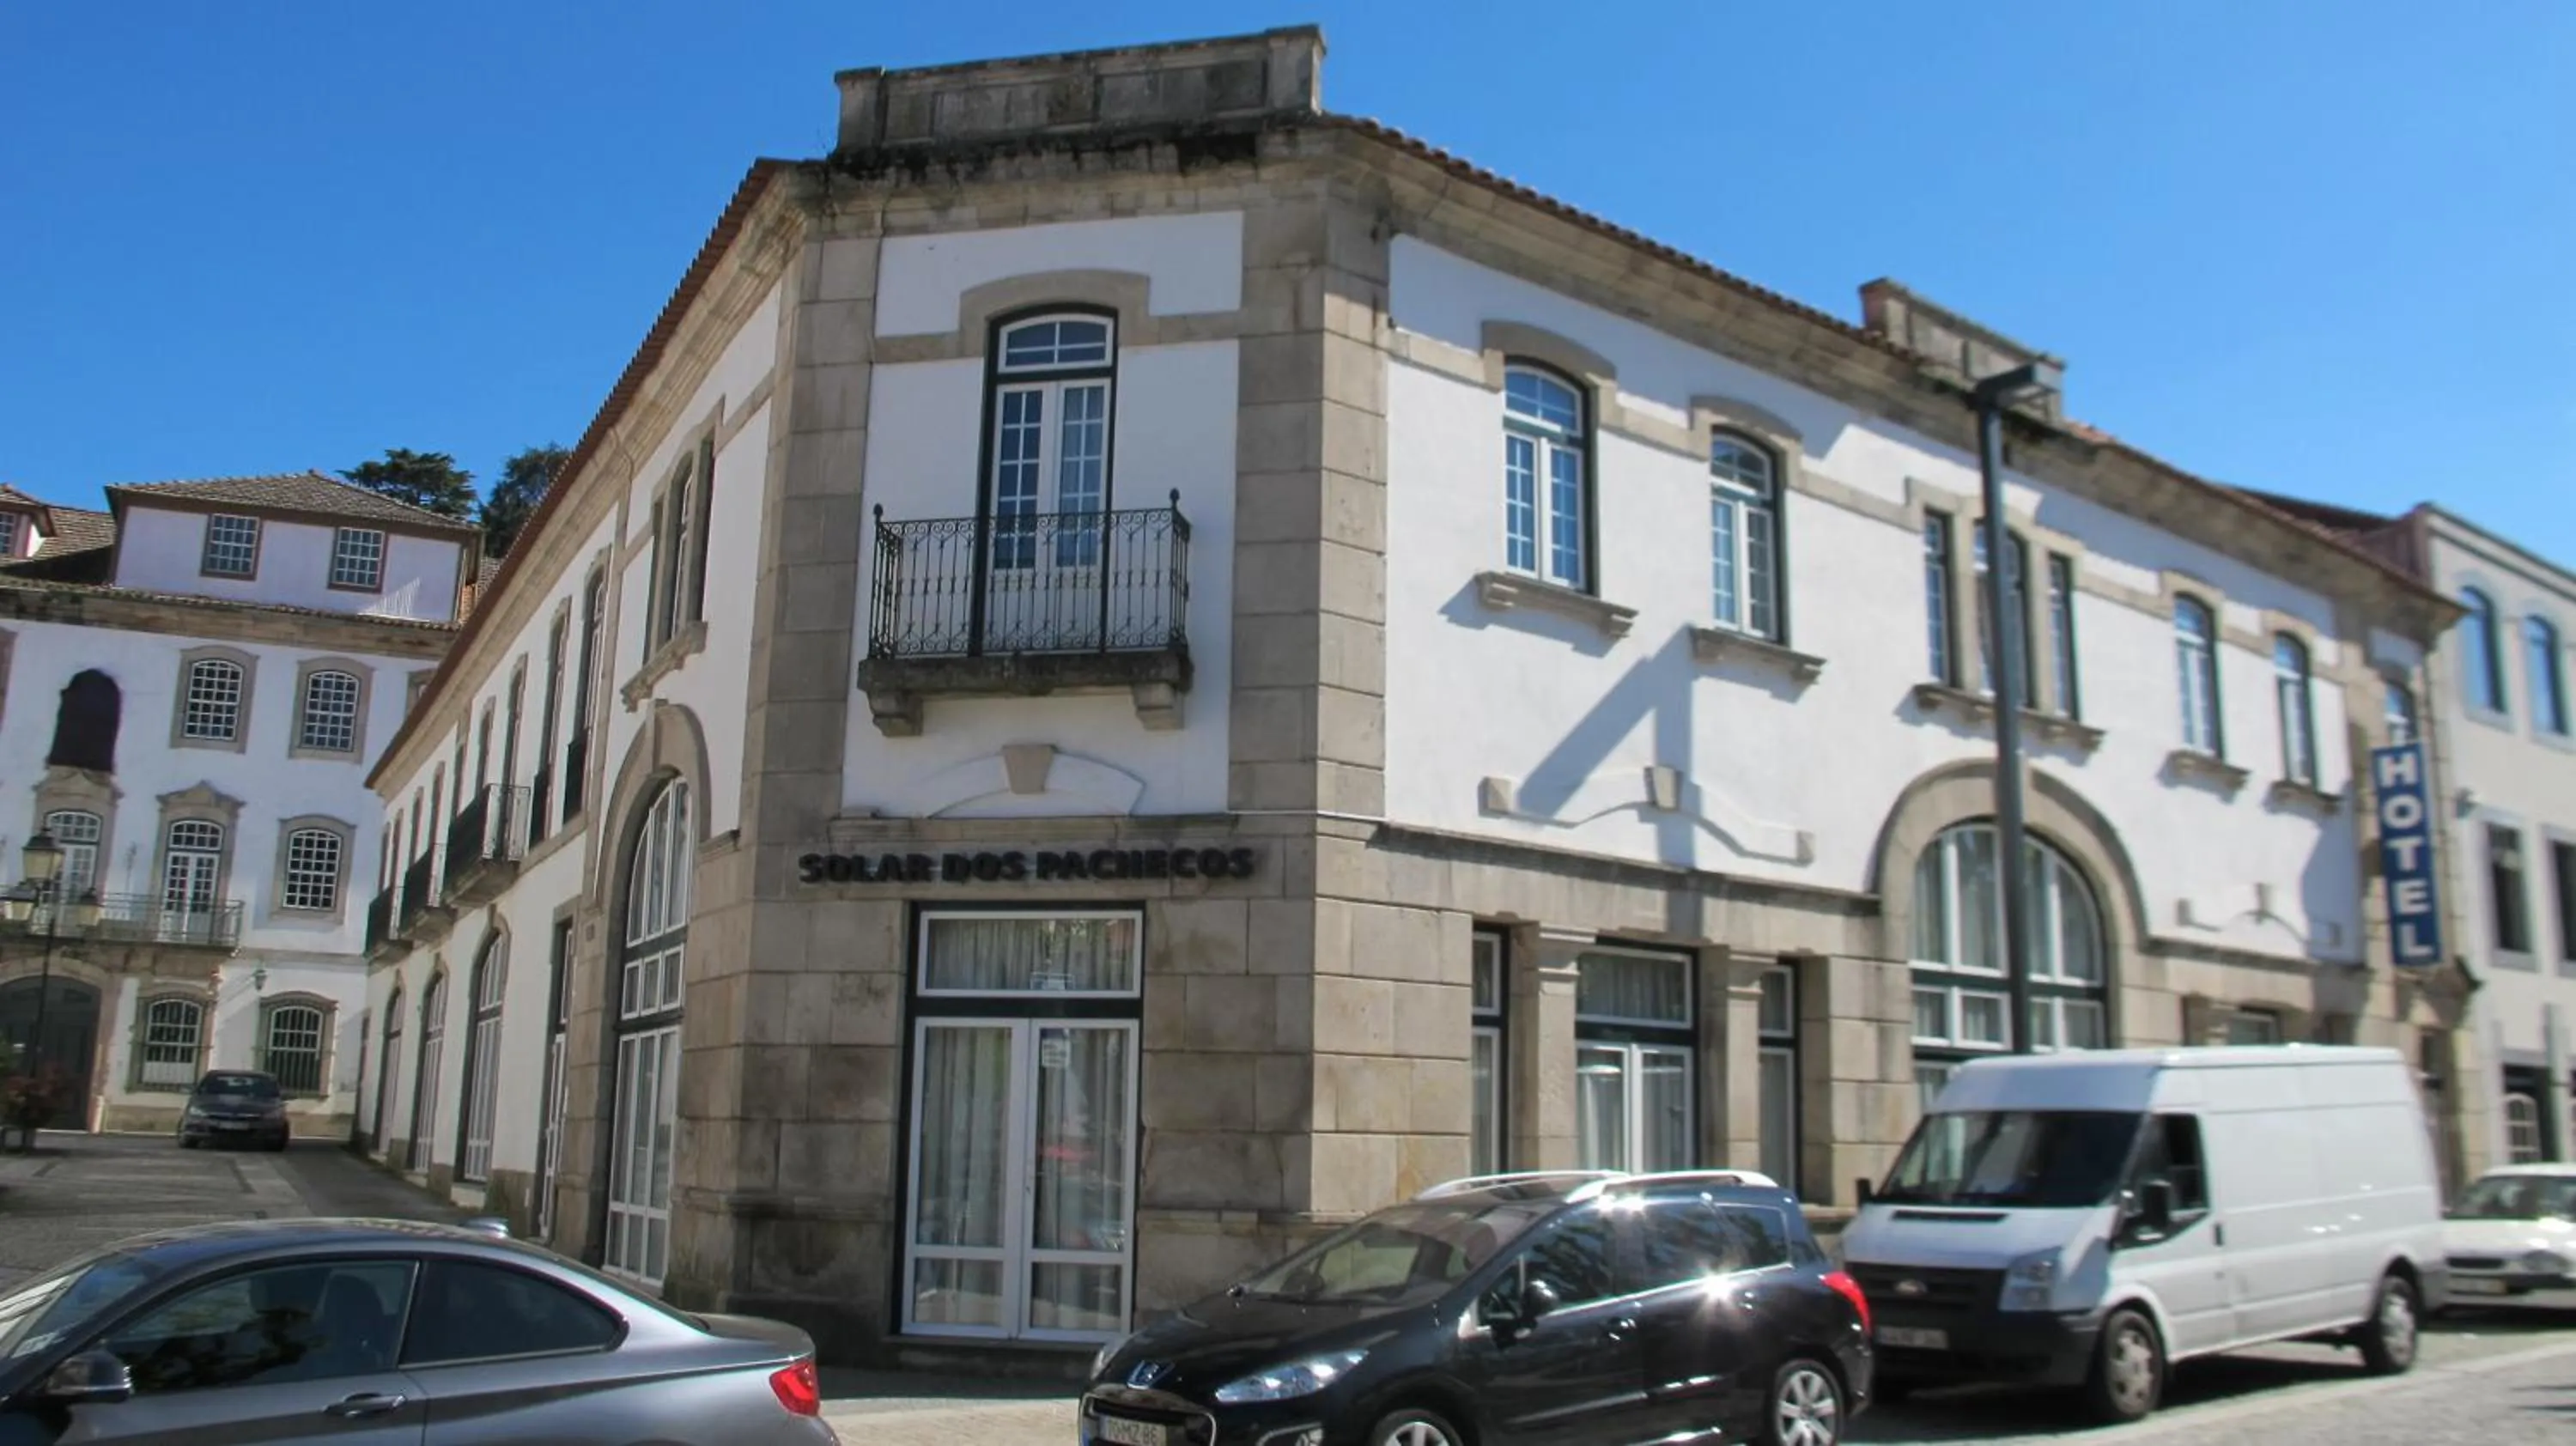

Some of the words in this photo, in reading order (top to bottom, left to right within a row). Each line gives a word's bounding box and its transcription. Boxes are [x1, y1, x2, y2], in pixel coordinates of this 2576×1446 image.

[799, 852, 934, 883] SOLAR
[942, 850, 1027, 882] DOS
[1036, 847, 1255, 880] PACHECOS
[2376, 752, 2434, 957] HOTEL
